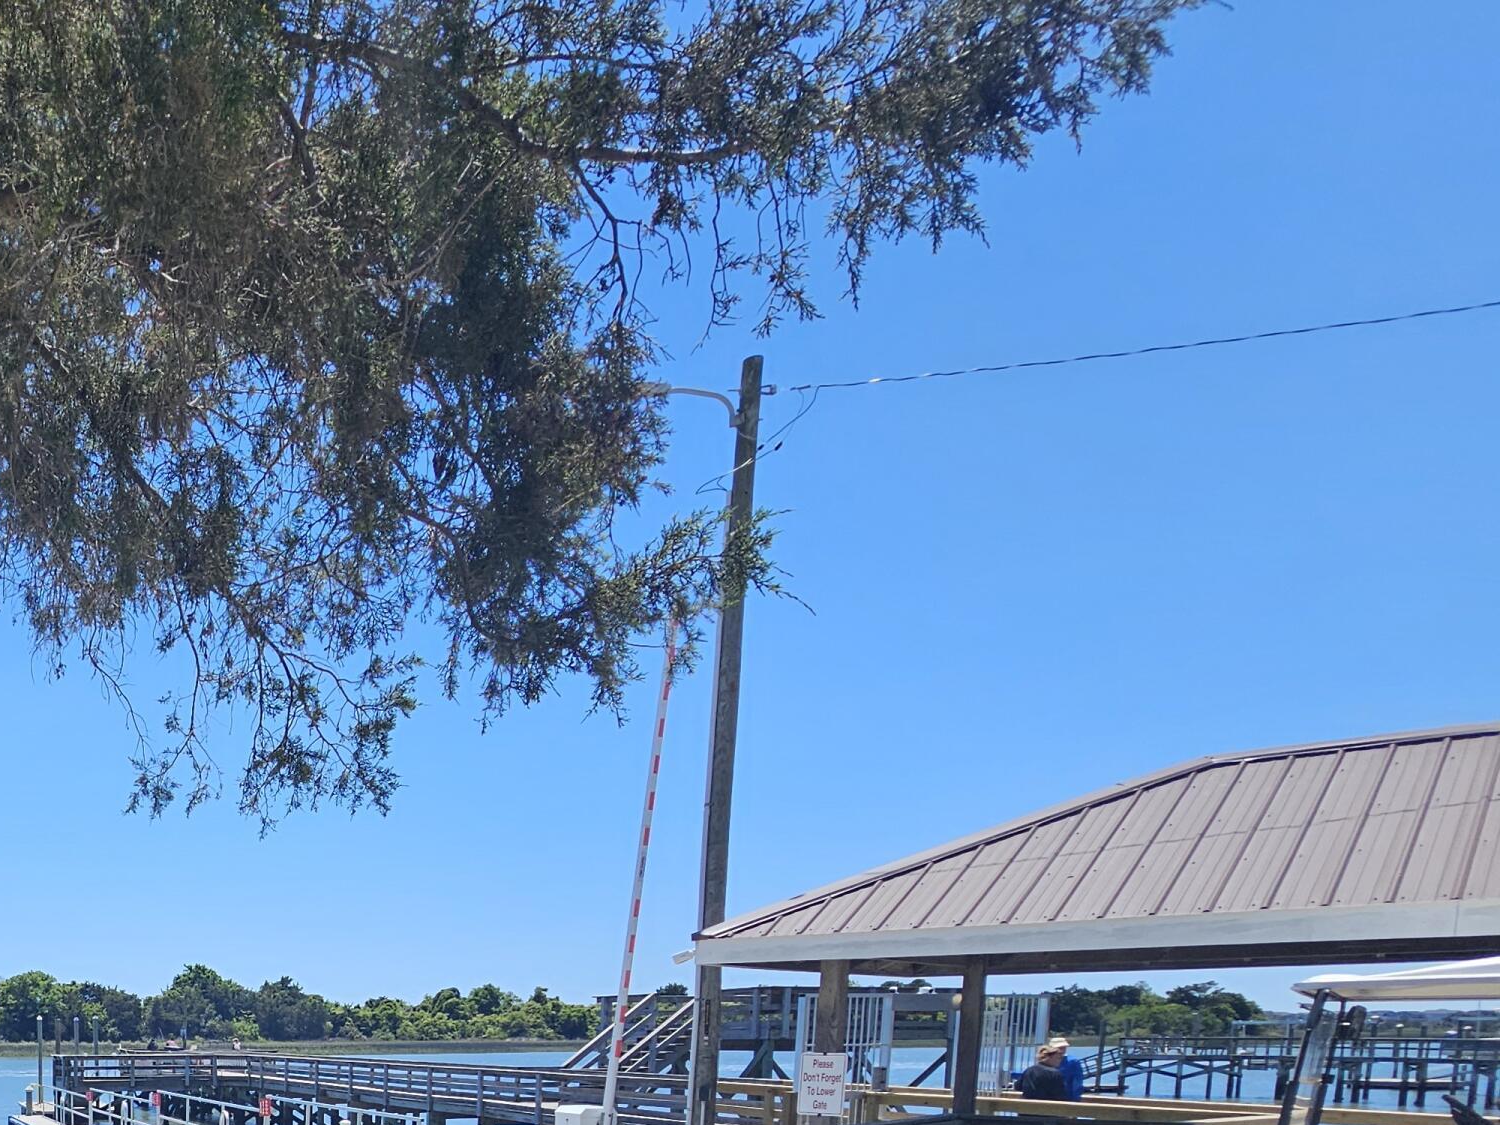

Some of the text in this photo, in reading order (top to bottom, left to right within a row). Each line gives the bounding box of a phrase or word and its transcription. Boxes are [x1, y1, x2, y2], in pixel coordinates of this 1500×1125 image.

[813, 1059, 834, 1068] Please
[803, 1072, 842, 1085] Don't Forget
[807, 1086, 836, 1096] To Lower
[812, 1100, 827, 1110] Gate
